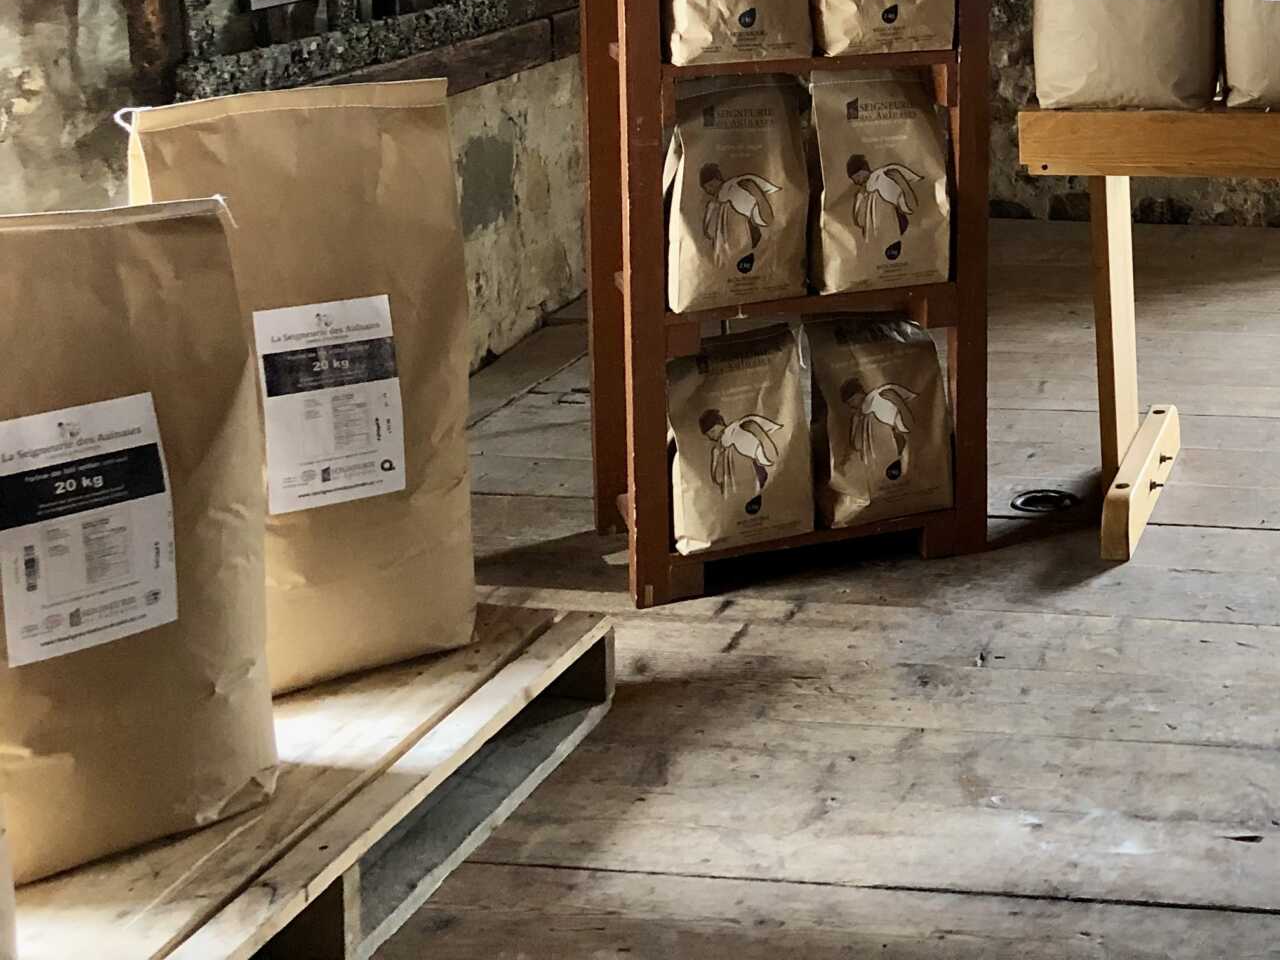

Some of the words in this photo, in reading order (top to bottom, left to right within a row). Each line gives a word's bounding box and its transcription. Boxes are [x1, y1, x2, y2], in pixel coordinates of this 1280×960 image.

[312, 360, 329, 371] 20
[332, 359, 350, 370] kg
[54, 478, 77, 495] 20
[81, 475, 104, 488] kg
